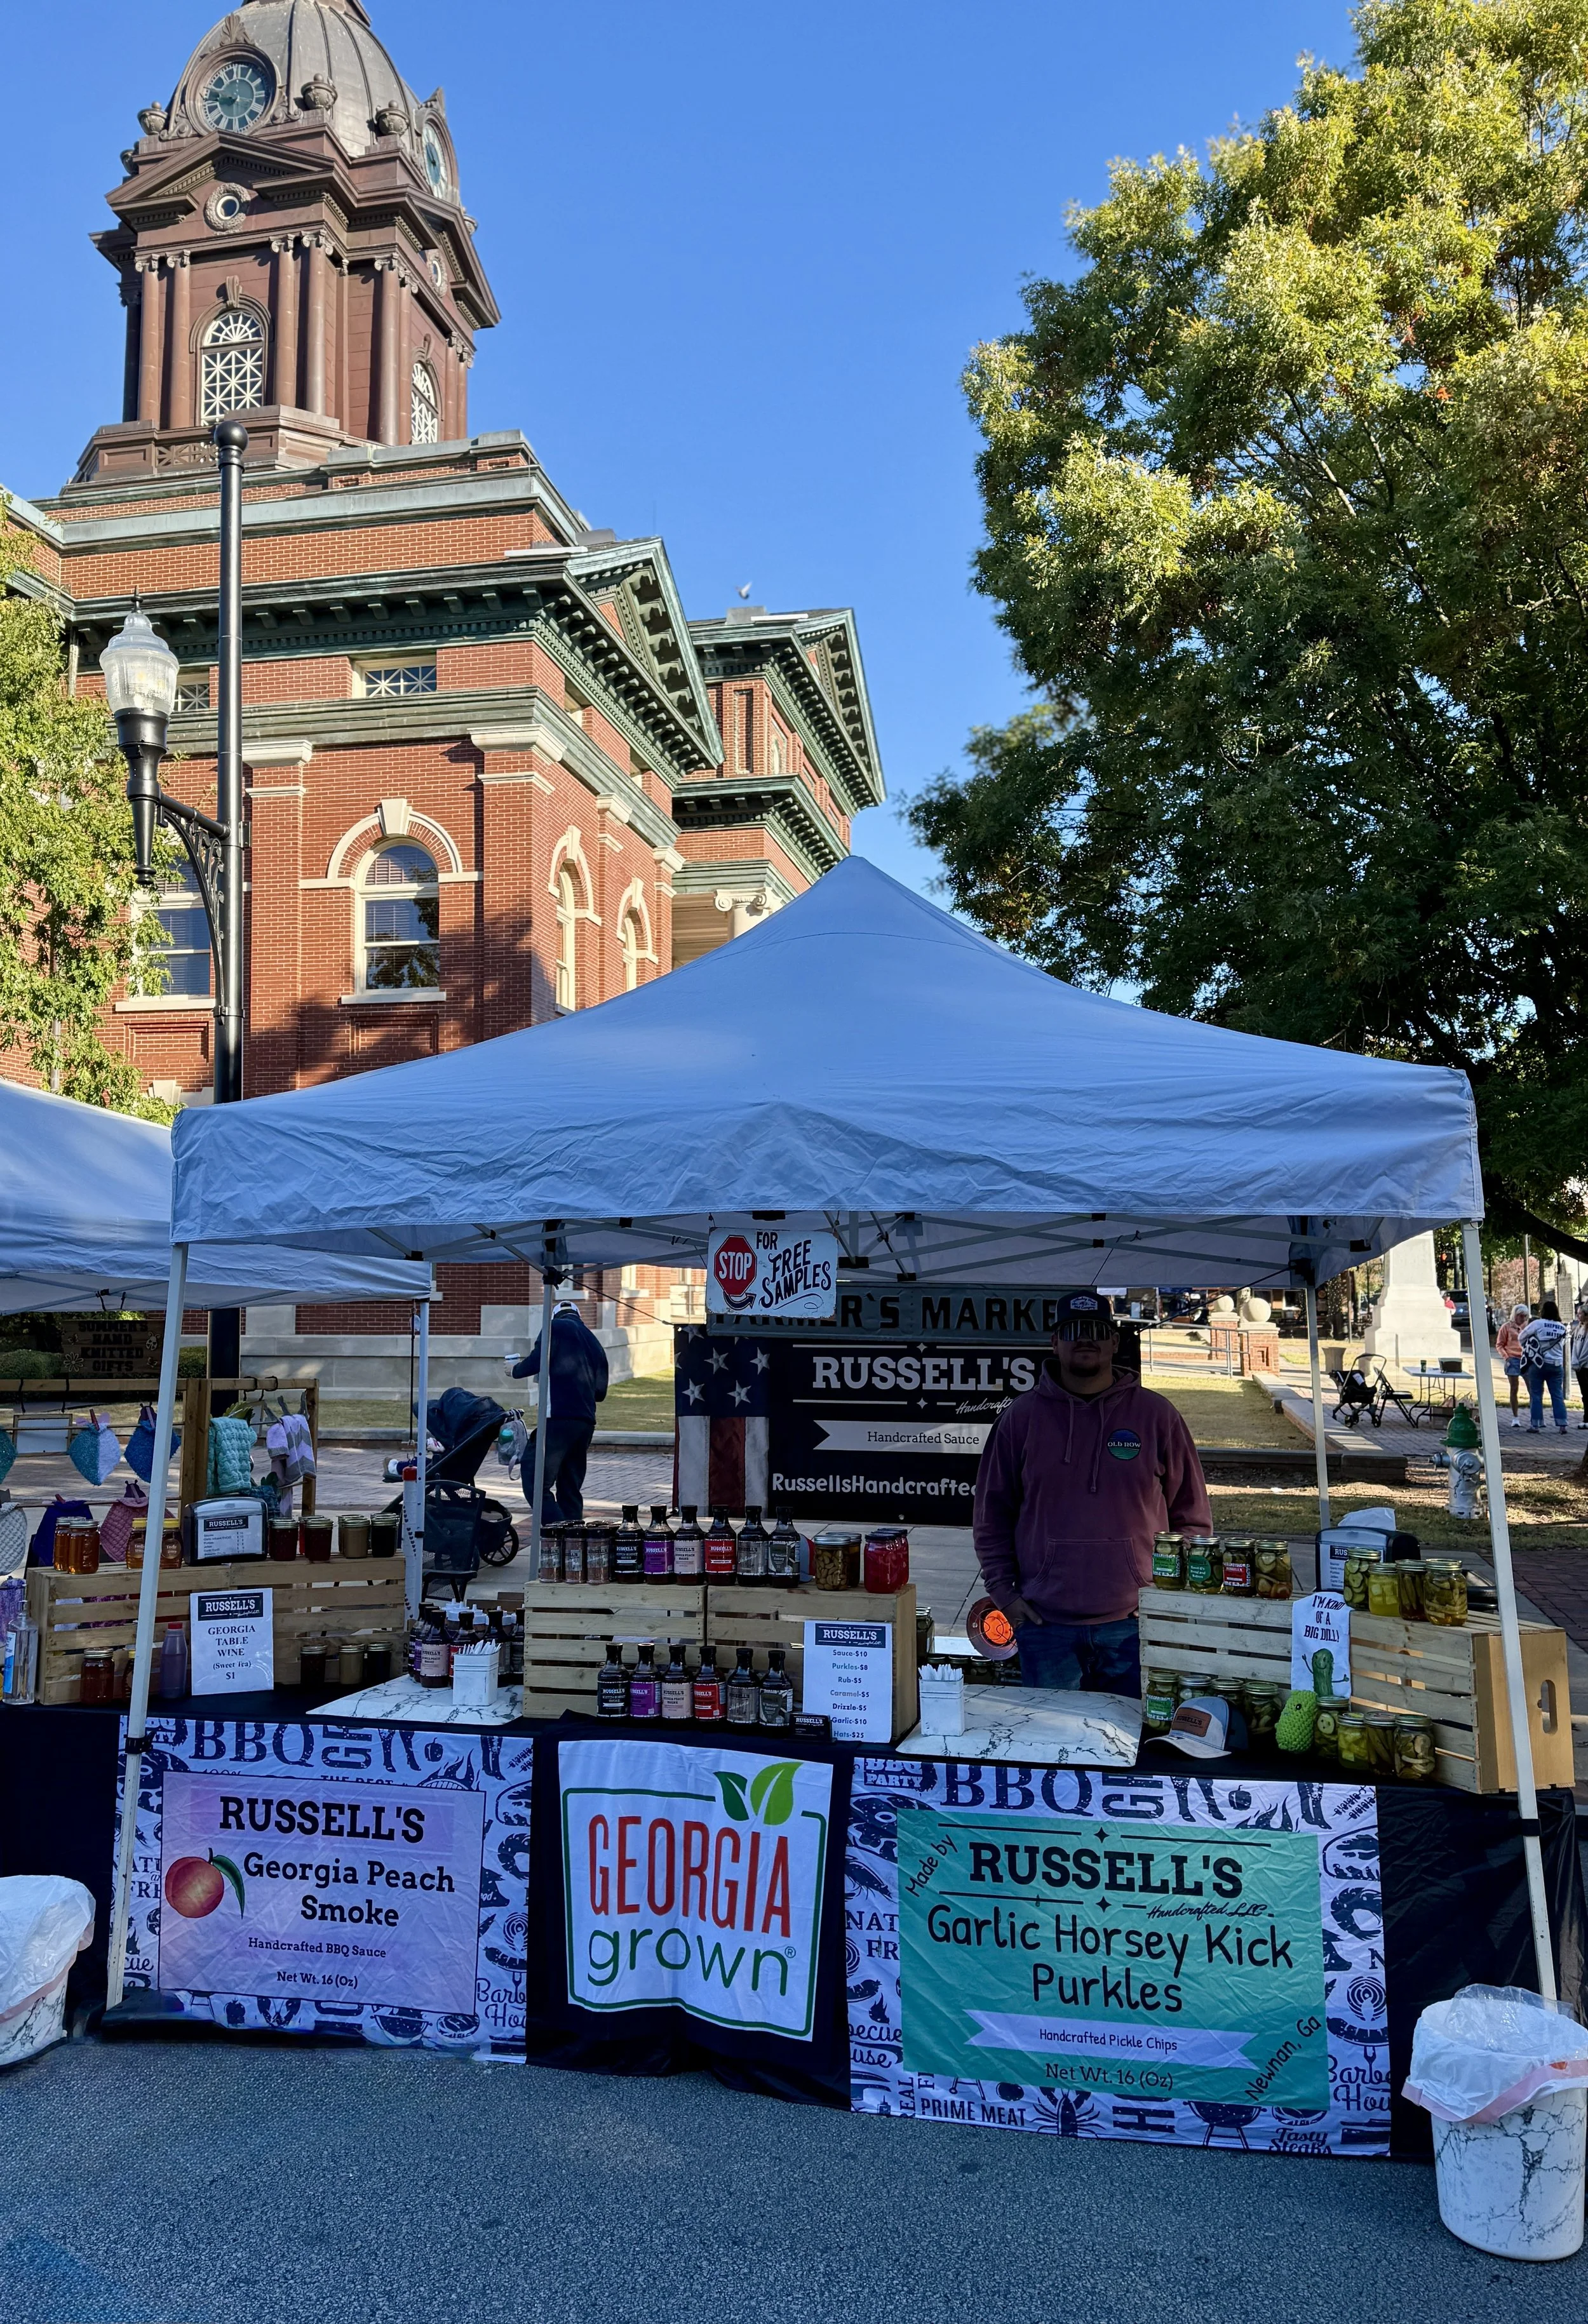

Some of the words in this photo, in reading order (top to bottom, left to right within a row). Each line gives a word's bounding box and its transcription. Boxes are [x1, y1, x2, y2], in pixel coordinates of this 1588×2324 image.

[756, 1231, 778, 1251] FOR
[718, 1251, 753, 1280] STOP
[768, 1239, 812, 1282] FREE
[758, 1261, 831, 1308] SAMPLES
[922, 1296, 1058, 1332] MARKE
[81, 1347, 144, 1359] KNITTED
[92, 1360, 133, 1372] GIFTS
[812, 1356, 1035, 1392] RUSSELL'S
[956, 1395, 1014, 1414] Handcraft
[867, 1431, 941, 1444] Handcrafted
[944, 1433, 979, 1445] Sauce
[209, 1519, 243, 1528] RUSSELL'S
[205, 1599, 255, 1613] RUSSELL'S
[1312, 1595, 1327, 1608] I'M
[1324, 1598, 1346, 1610] KIND
[1315, 1610, 1324, 1624] OF
[1326, 1612, 1331, 1625] A
[208, 1625, 256, 1636] GEORGIA
[823, 1629, 877, 1640] RUSSELL'S
[1303, 1625, 1319, 1639] BIG
[1321, 1627, 1340, 1642] DILL!
[215, 1637, 248, 1646] TABLE
[217, 1648, 245, 1657] WINE
[830, 1689, 870, 1698] Caramel-$5
[831, 1717, 866, 1725] Garlic-$10
[1176, 1715, 1202, 1726] RUSSELL'S
[189, 1719, 314, 1768] BBQ
[865, 1772, 923, 1788] PARTY
[940, 1763, 1094, 1817] BBQ
[219, 1796, 425, 1843] RUSSELL'S
[243, 1851, 359, 1889] Georgia
[367, 1860, 455, 1893] Peach
[588, 1813, 791, 1938] GEORGIA
[905, 1856, 938, 1897] Made
[931, 1834, 959, 1856] by
[969, 1841, 1243, 1898] RUSSELL'S
[300, 1895, 400, 1927] Smoke
[1145, 1901, 1227, 1921] Handcrafted
[248, 1937, 323, 1953] Handcrafted
[325, 1943, 349, 1958] BBQ
[351, 1945, 387, 1958] Sauce
[927, 1904, 1041, 1951] Garlic
[1055, 1914, 1189, 1978] Horsey
[1205, 1923, 1293, 1969] Kick
[586, 1927, 788, 1997] grown
[277, 1971, 298, 1982] Net
[300, 1973, 320, 1985] Wt.
[321, 1974, 333, 1985] 16
[335, 1974, 358, 1989] (Oz)
[1032, 1963, 1183, 2012] Purkles
[1040, 2029, 1106, 2045] Handcrafted
[1109, 2034, 1143, 2048] Pickle
[1146, 2037, 1178, 2055] Chips
[1244, 2040, 1302, 2102] Newnan,
[1296, 2016, 1322, 2038] Ga
[1046, 2063, 1075, 2080] Net
[1079, 2065, 1112, 2083] Wt.
[1117, 2069, 1135, 2085] 16
[1140, 2071, 1173, 2091] (Oz)
[921, 2097, 975, 2121] PRIME
[981, 2104, 1026, 2126] MEAT
[1275, 2127, 1328, 2147] Tasty
